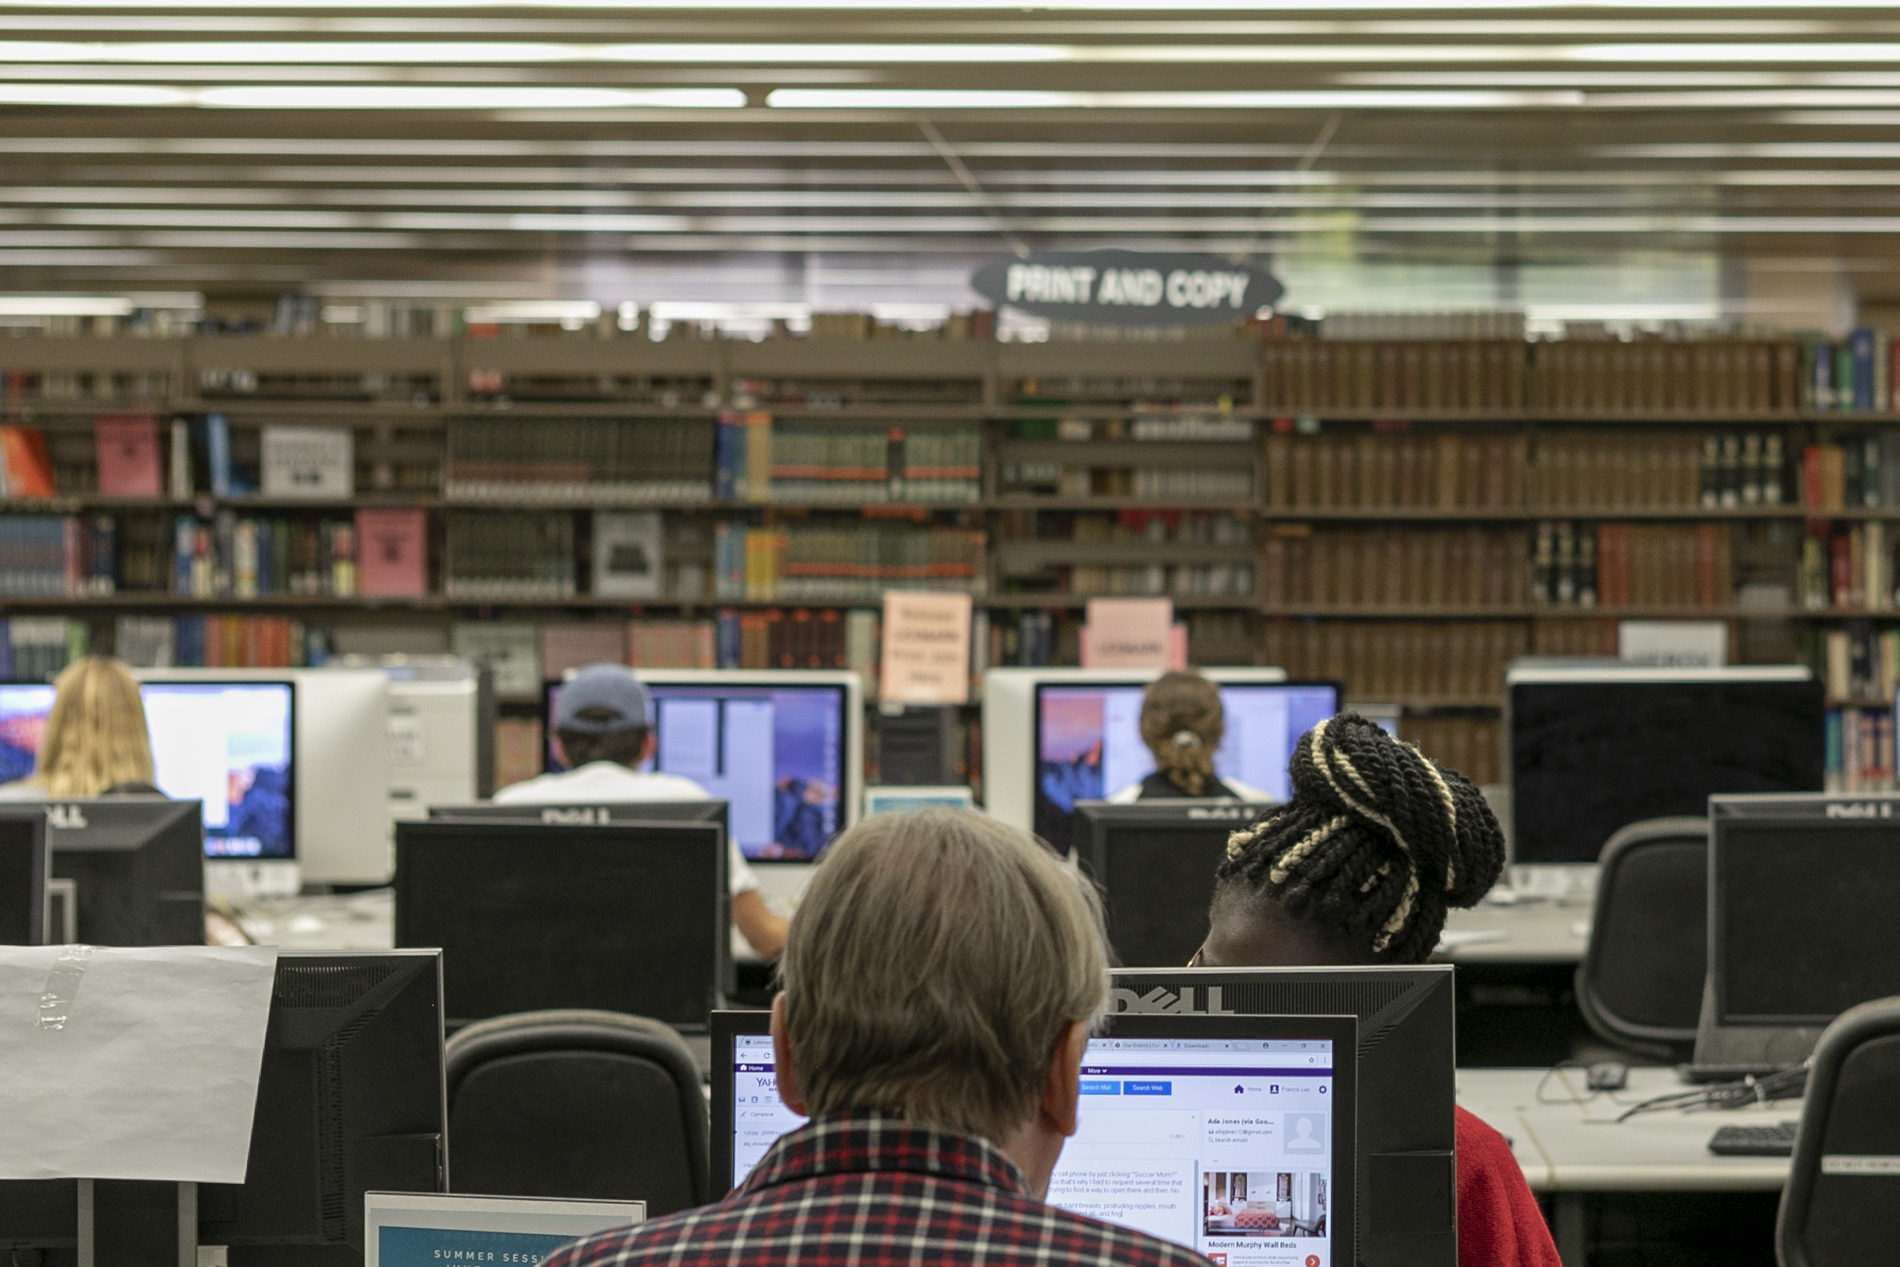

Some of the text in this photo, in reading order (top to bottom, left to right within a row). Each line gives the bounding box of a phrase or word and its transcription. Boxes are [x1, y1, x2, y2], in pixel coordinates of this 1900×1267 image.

[1007, 264, 1249, 308] PRINT AND COPY
[1108, 985, 1235, 1015] DELL
[756, 1077, 776, 1087] YAH
[434, 1250, 494, 1261] SUMMER
